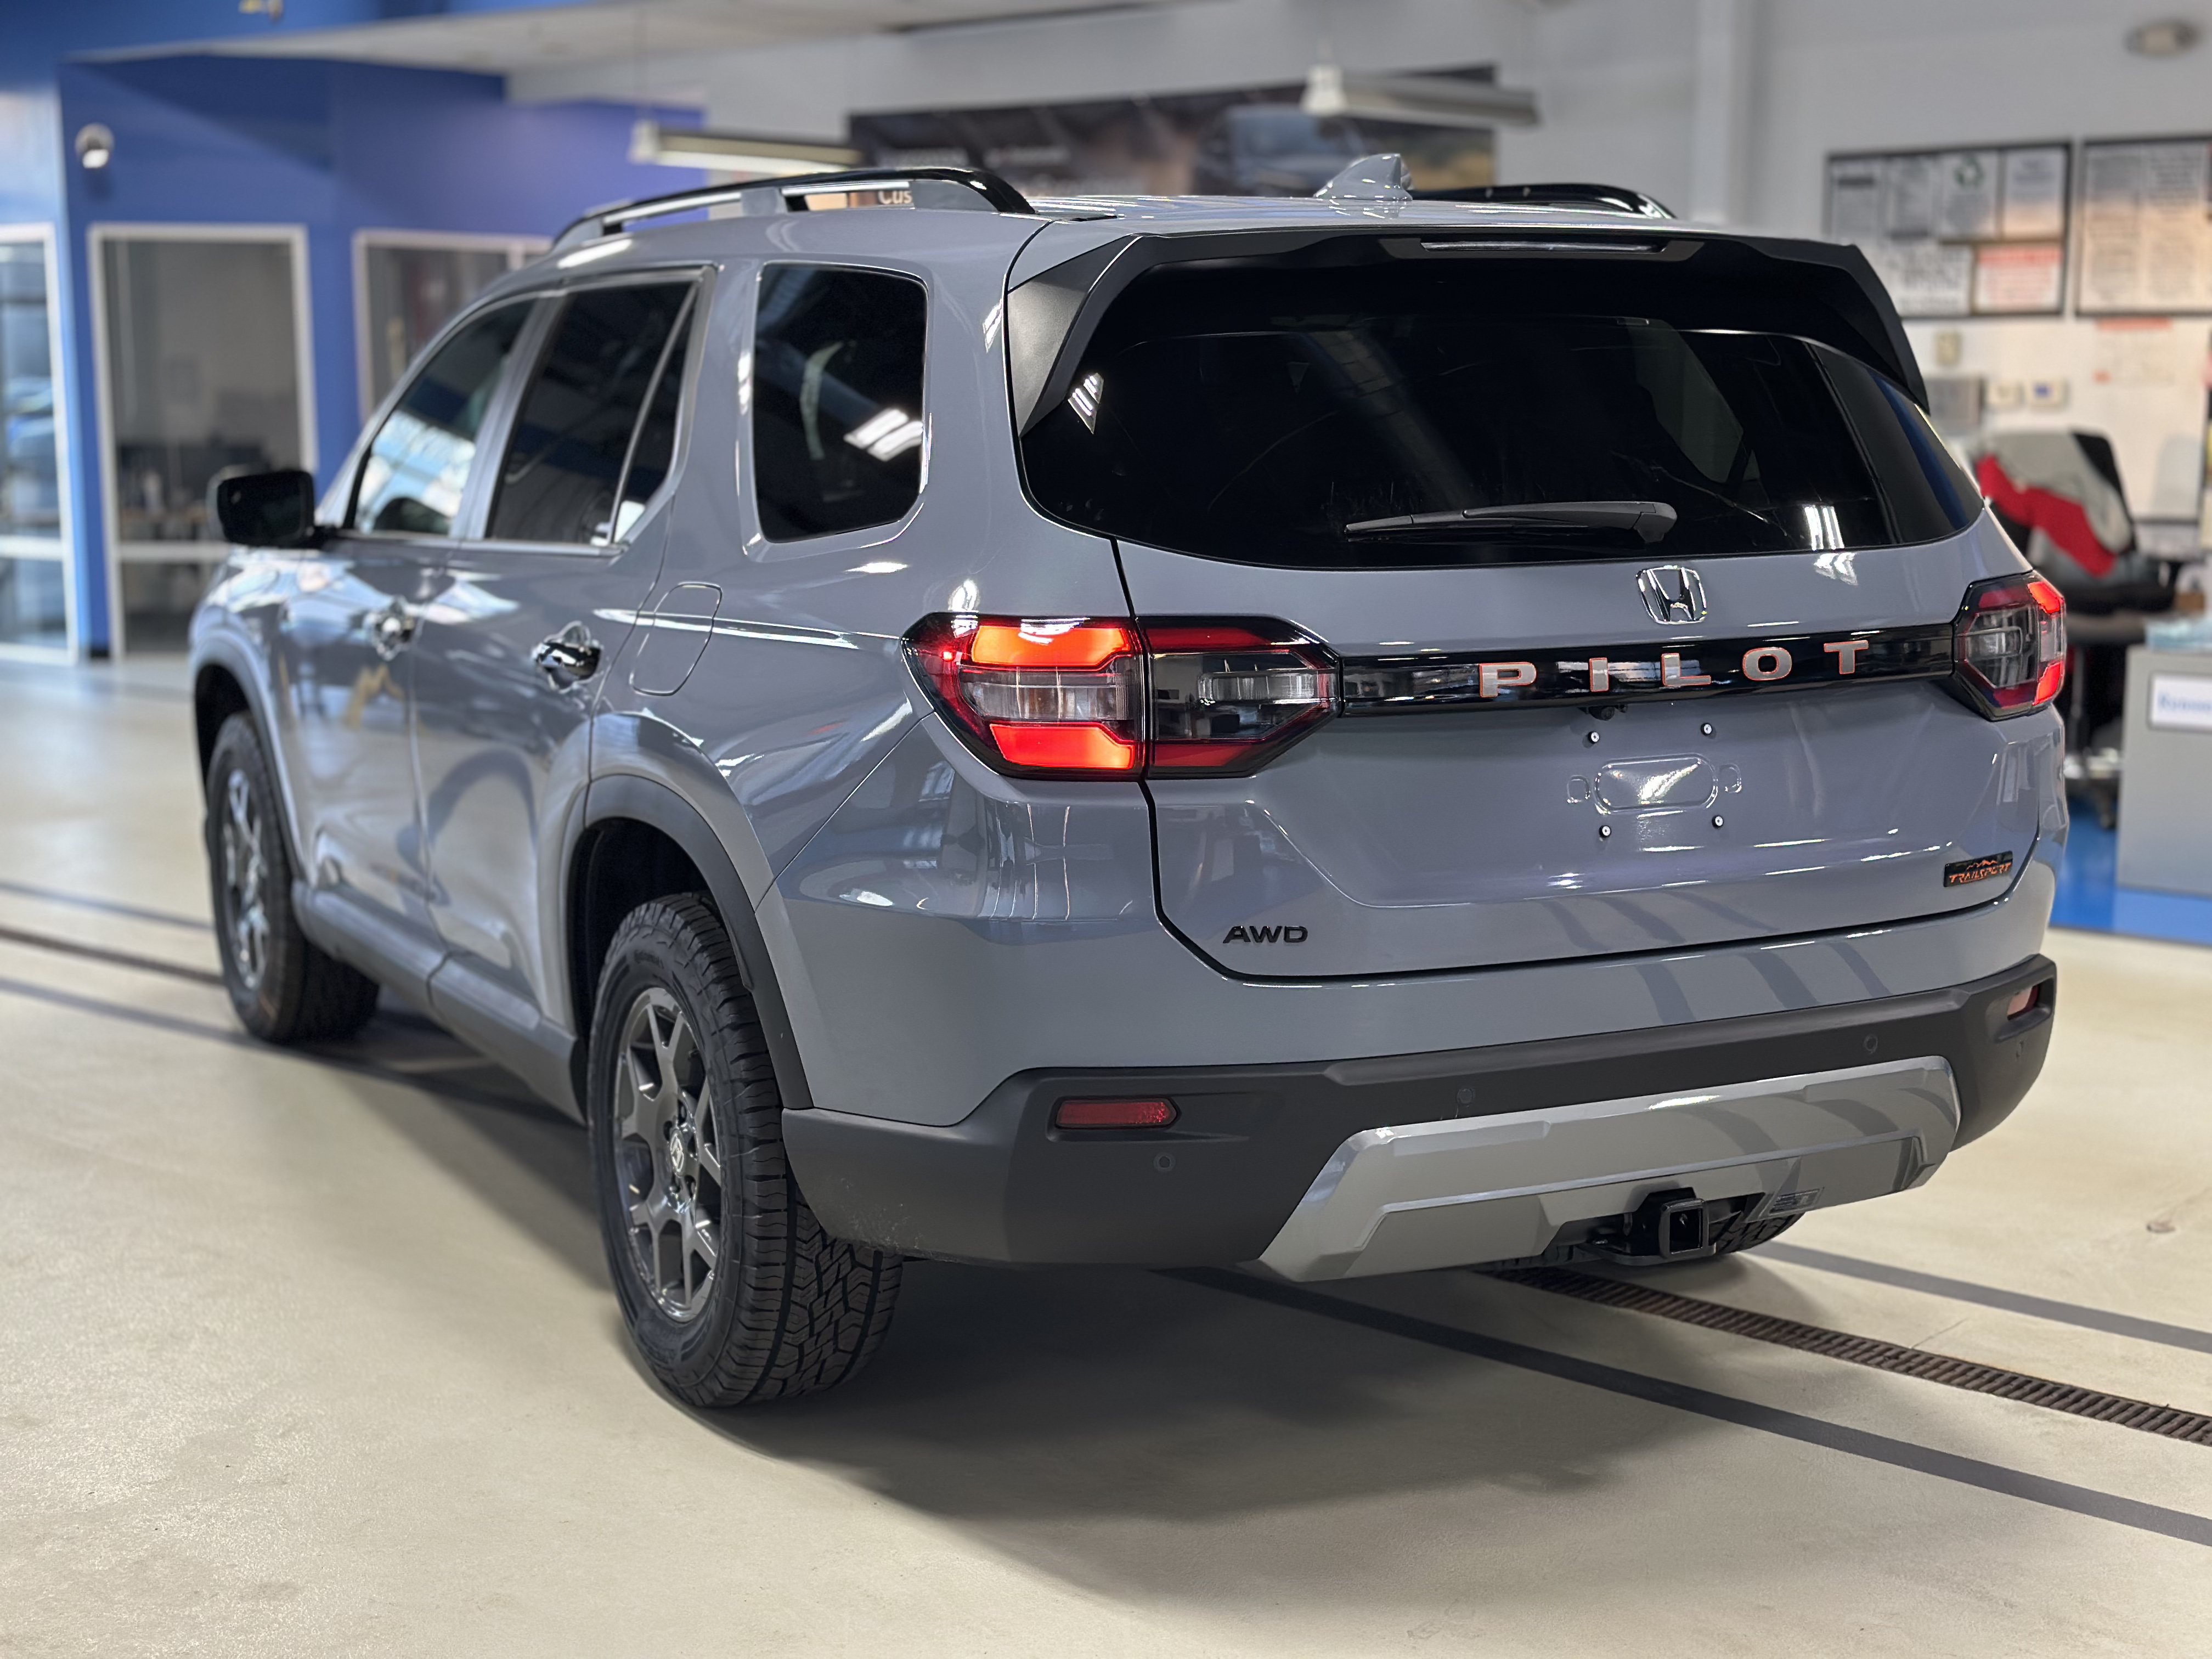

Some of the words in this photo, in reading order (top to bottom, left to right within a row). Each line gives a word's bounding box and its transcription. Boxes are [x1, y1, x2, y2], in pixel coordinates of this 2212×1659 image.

[1479, 640, 1869, 698] PILOT
[1949, 862, 2012, 883] TRAILSPORT
[1223, 926, 1308, 944] AWD
